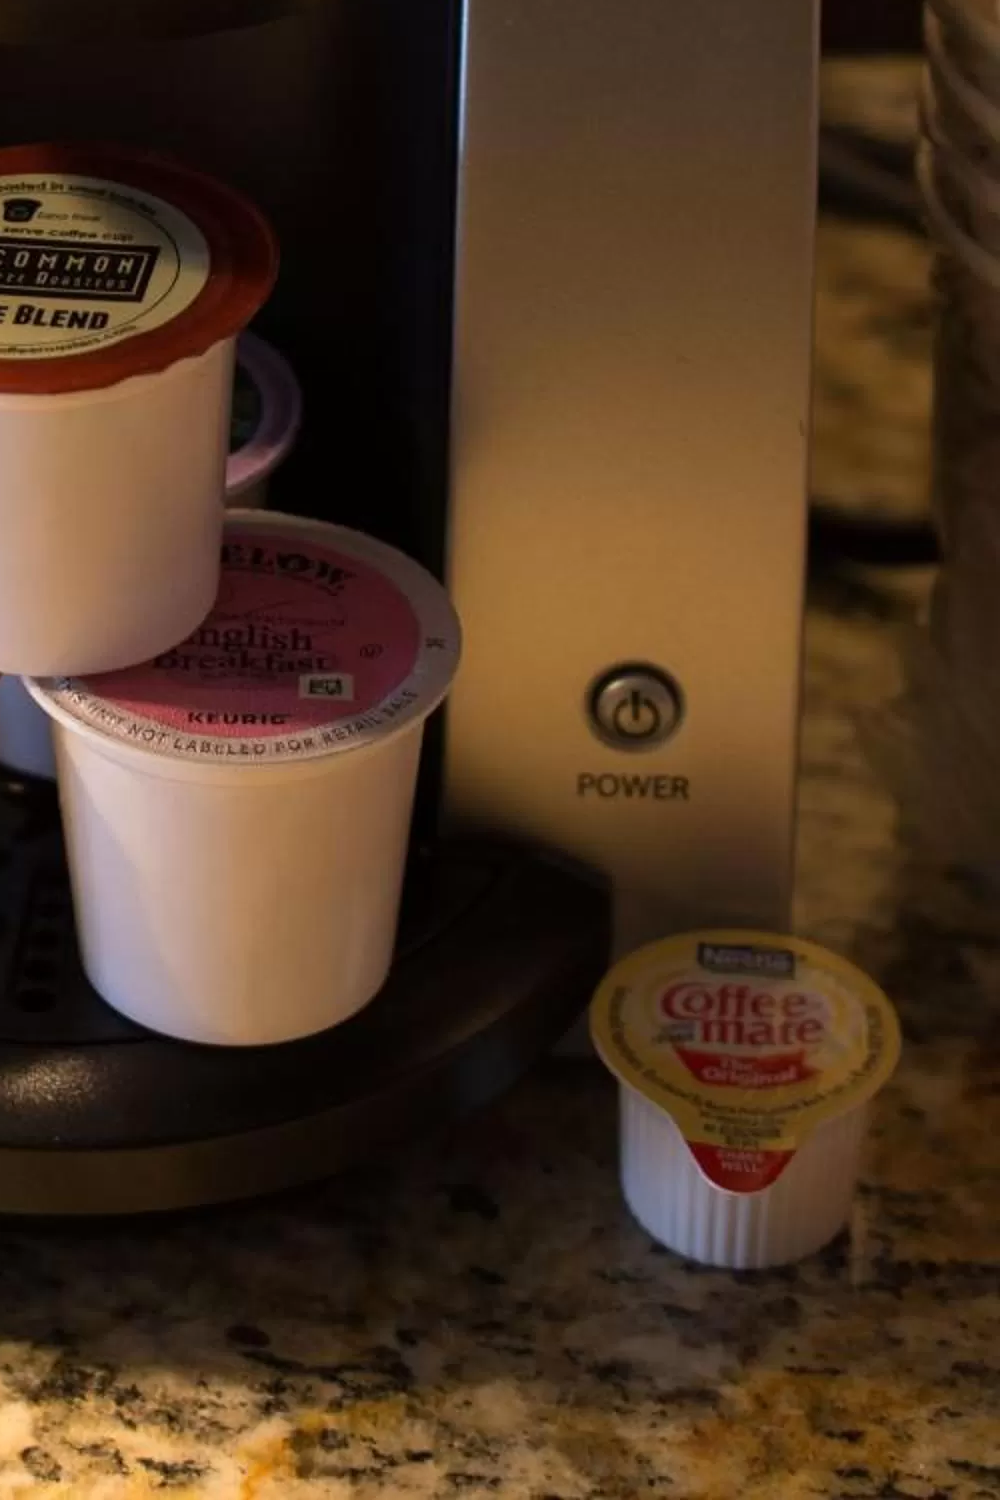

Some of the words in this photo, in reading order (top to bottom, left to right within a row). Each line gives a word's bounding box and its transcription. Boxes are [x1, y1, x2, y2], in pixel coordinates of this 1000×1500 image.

[12, 303, 110, 330] BLEND
[128, 721, 170, 745] NOT
[274, 737, 315, 754] FOR
[576, 771, 691, 801] POWER
[700, 1018, 825, 1047] mate
